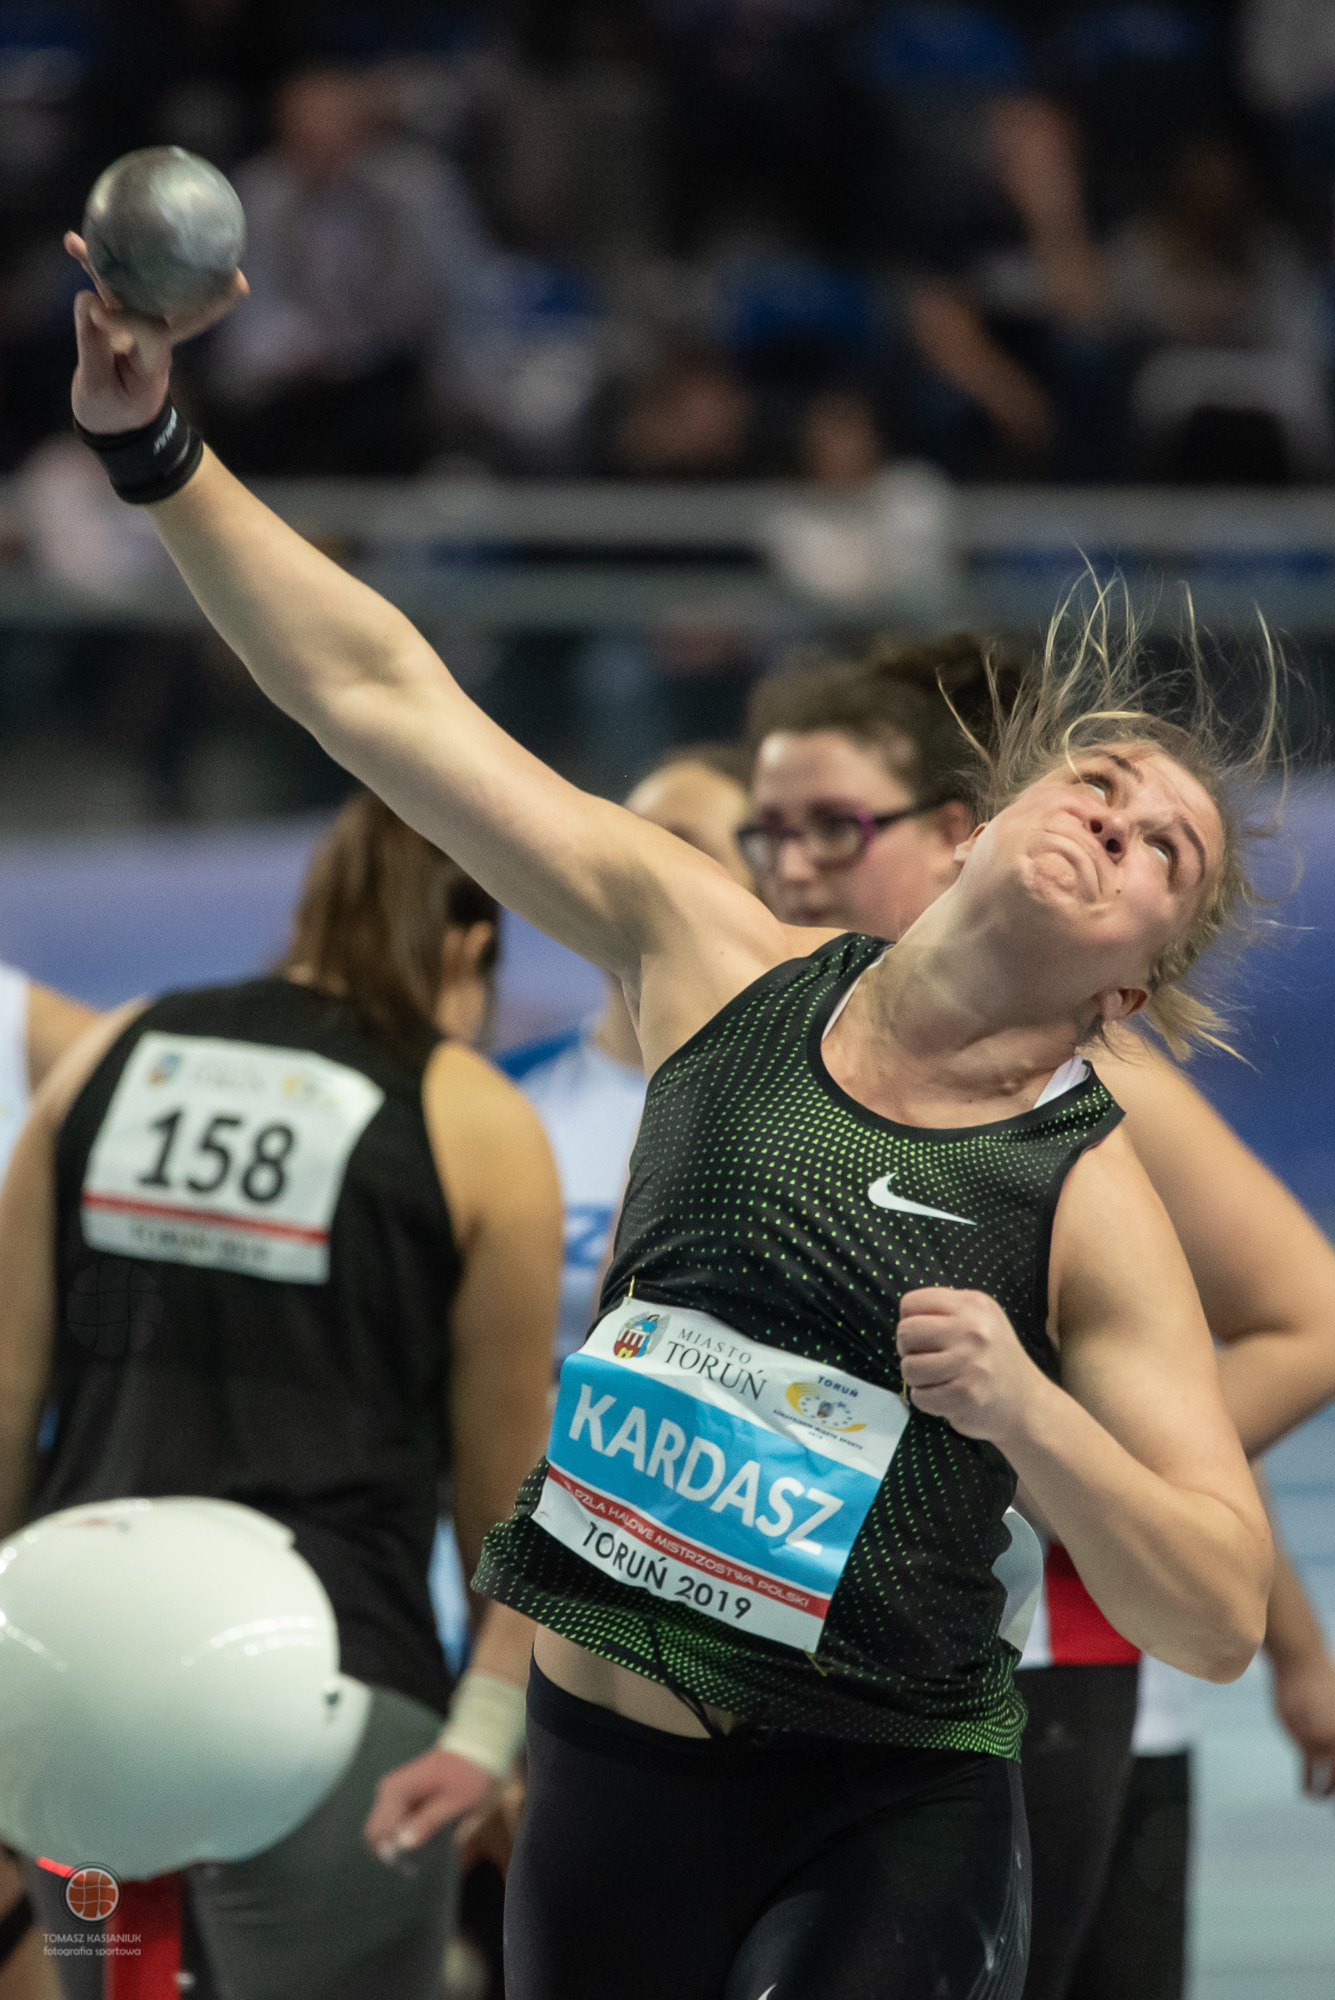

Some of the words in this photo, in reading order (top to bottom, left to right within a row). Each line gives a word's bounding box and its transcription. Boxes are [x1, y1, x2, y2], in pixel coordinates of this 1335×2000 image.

[137, 1108, 296, 1205] 158
[665, 1341, 768, 1401] TORUŃ
[679, 1328, 752, 1365] MIASTO
[568, 1384, 844, 1556] KARDASZ
[583, 1521, 668, 1590] TORUŃ
[674, 1575, 752, 1620] 2019
[608, 1506, 655, 1541] HALOWE
[654, 1535, 755, 1587] MISTRZOSTWA
[757, 1580, 809, 1607] POLSKI
